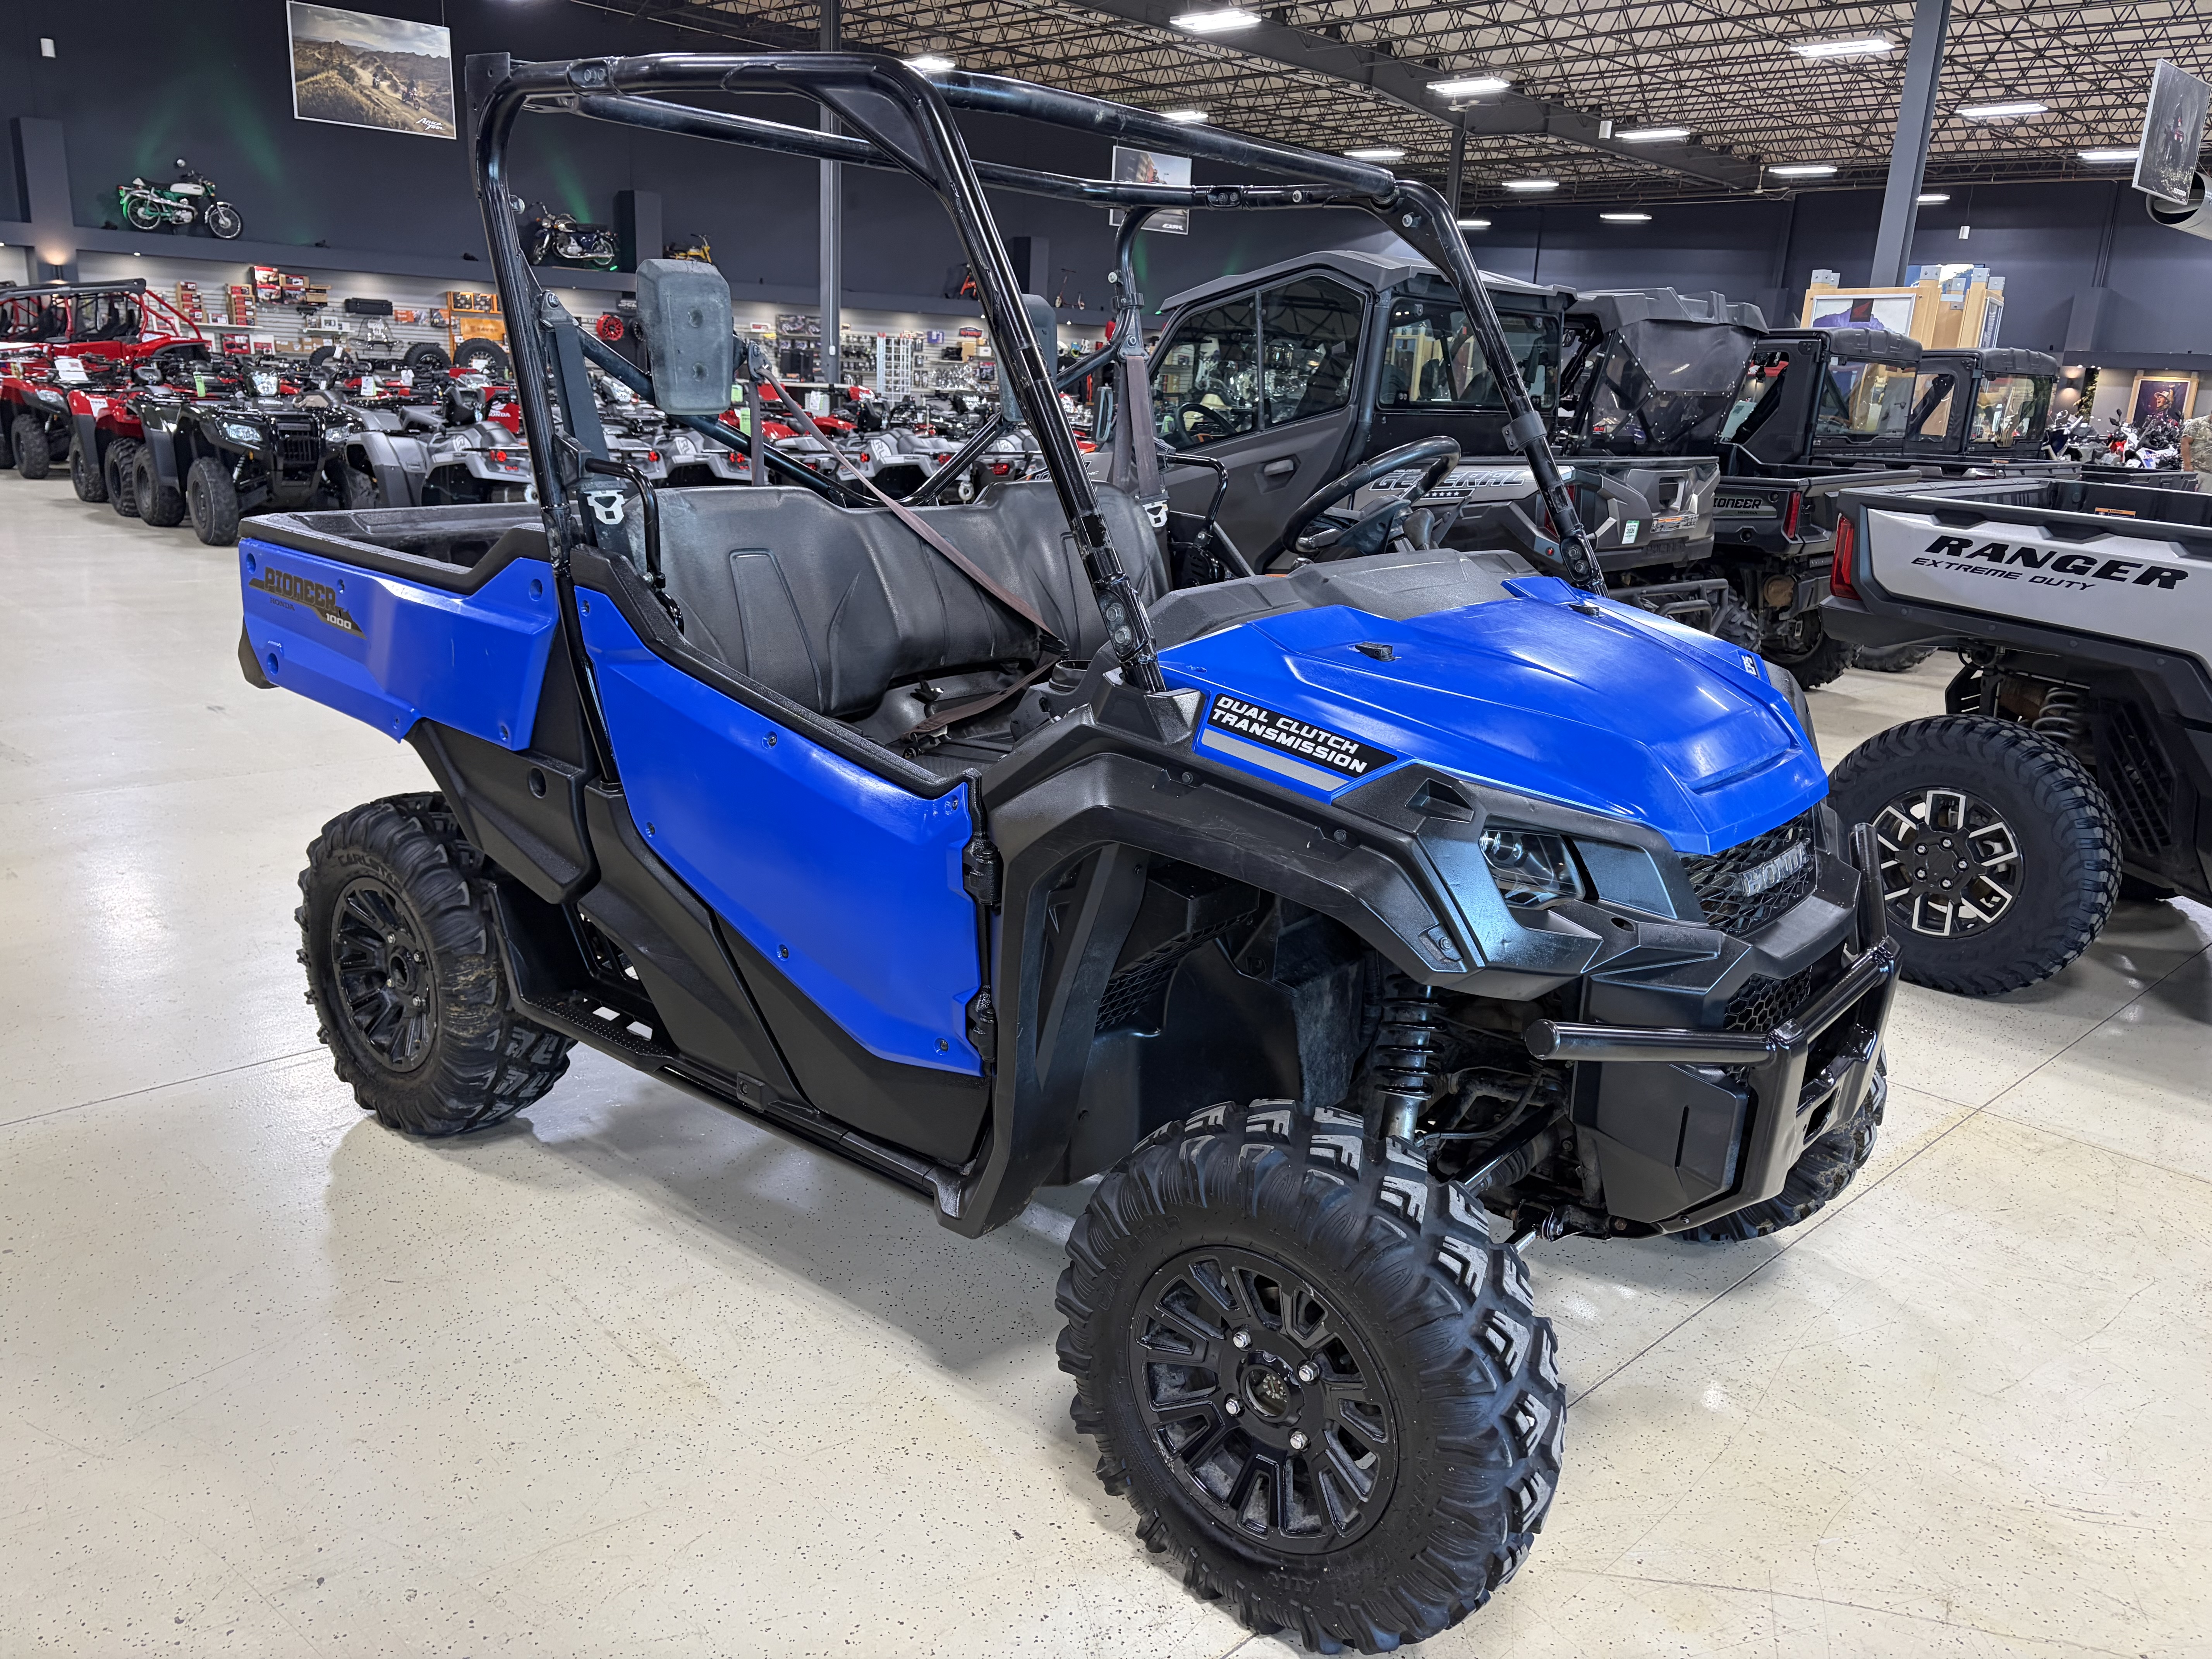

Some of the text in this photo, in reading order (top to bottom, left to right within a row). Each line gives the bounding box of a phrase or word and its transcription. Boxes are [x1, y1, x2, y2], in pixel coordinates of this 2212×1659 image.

[1369, 470, 1526, 491] GEERAL
[1713, 498, 1762, 509] IONEER
[1911, 557, 2096, 591] EXTREME DUTY
[1924, 535, 2189, 590] RANGER
[264, 567, 336, 613] PIONEER
[270, 597, 295, 611] HONDA
[326, 613, 352, 630] 1000
[1741, 655, 1757, 675] EPS
[1217, 696, 1359, 754] DUAL CLUTCH
[1212, 709, 1367, 773] TRANSMISSION
